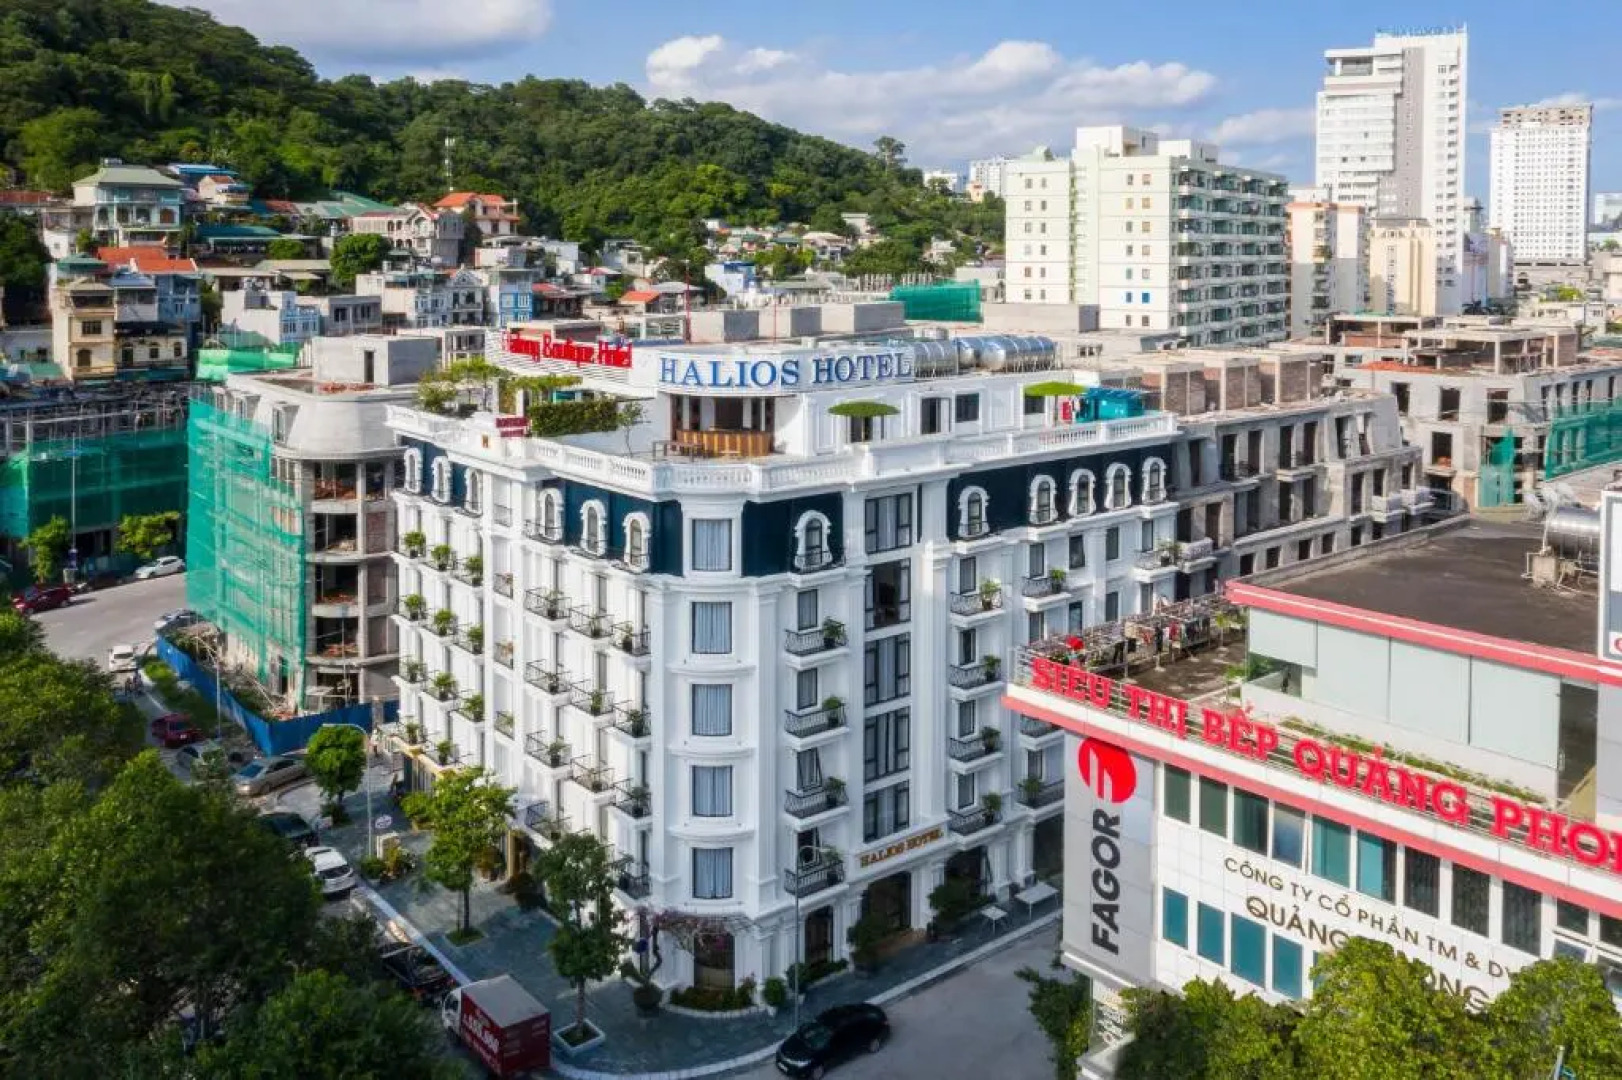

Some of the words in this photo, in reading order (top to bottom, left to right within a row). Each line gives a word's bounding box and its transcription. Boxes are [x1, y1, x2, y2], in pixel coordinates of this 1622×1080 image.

[658, 356, 800, 388] HALIOS
[812, 352, 913, 385] HOTEL
[1030, 656, 1114, 711] SIÊU
[1201, 701, 1279, 762] BẾP
[1292, 737, 1471, 826] QUẢNG
[1090, 808, 1121, 956] FAGOR
[1223, 857, 1284, 891] CÔNG
[1290, 881, 1313, 902] TY
[1318, 894, 1351, 918] CỔ
[1426, 935, 1458, 962] TM
[1464, 952, 1481, 970] &
[1245, 895, 1350, 950] QUẢNG
